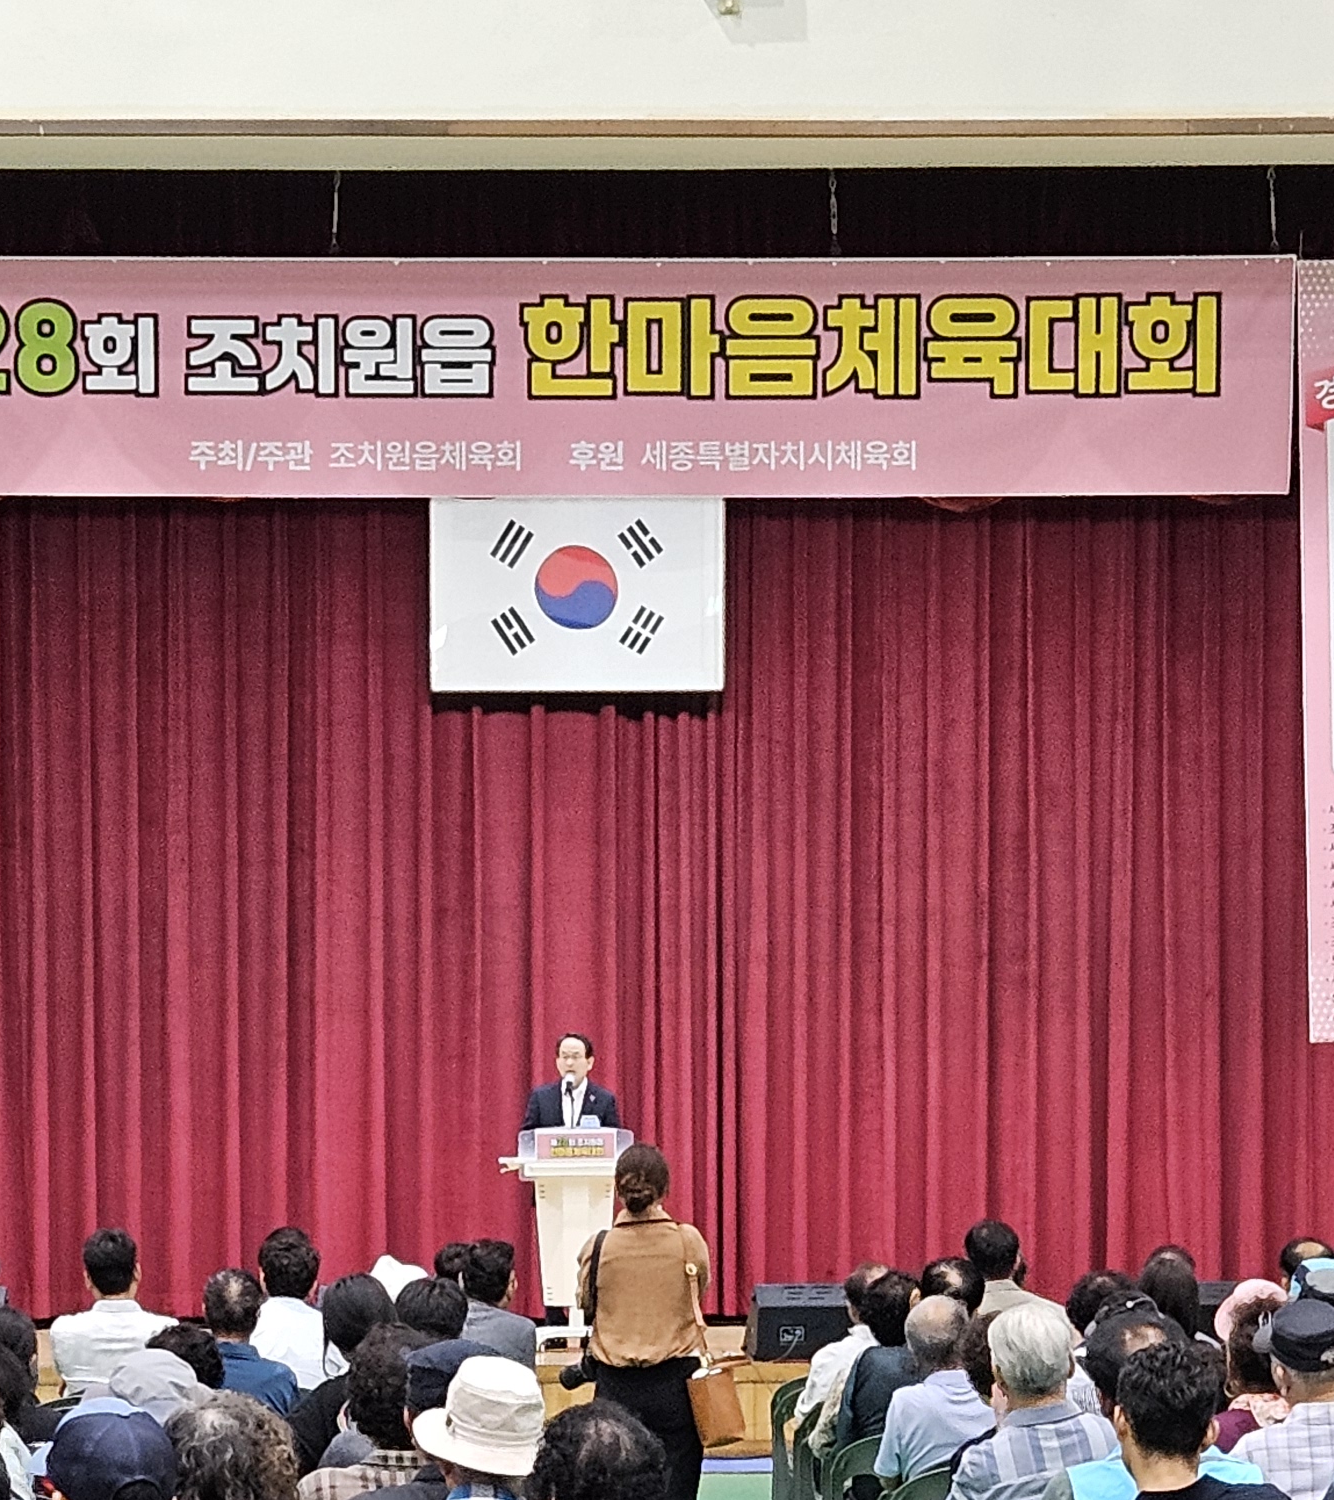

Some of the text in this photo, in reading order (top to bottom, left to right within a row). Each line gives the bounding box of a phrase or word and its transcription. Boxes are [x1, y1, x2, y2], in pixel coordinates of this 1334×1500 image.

[184, 313, 497, 398] 조치원읍
[519, 291, 1222, 400] 한마음체육대회
[188, 440, 918, 473] 주최/주관 조치원읍체육회 후원 세종특별자치시체육회
